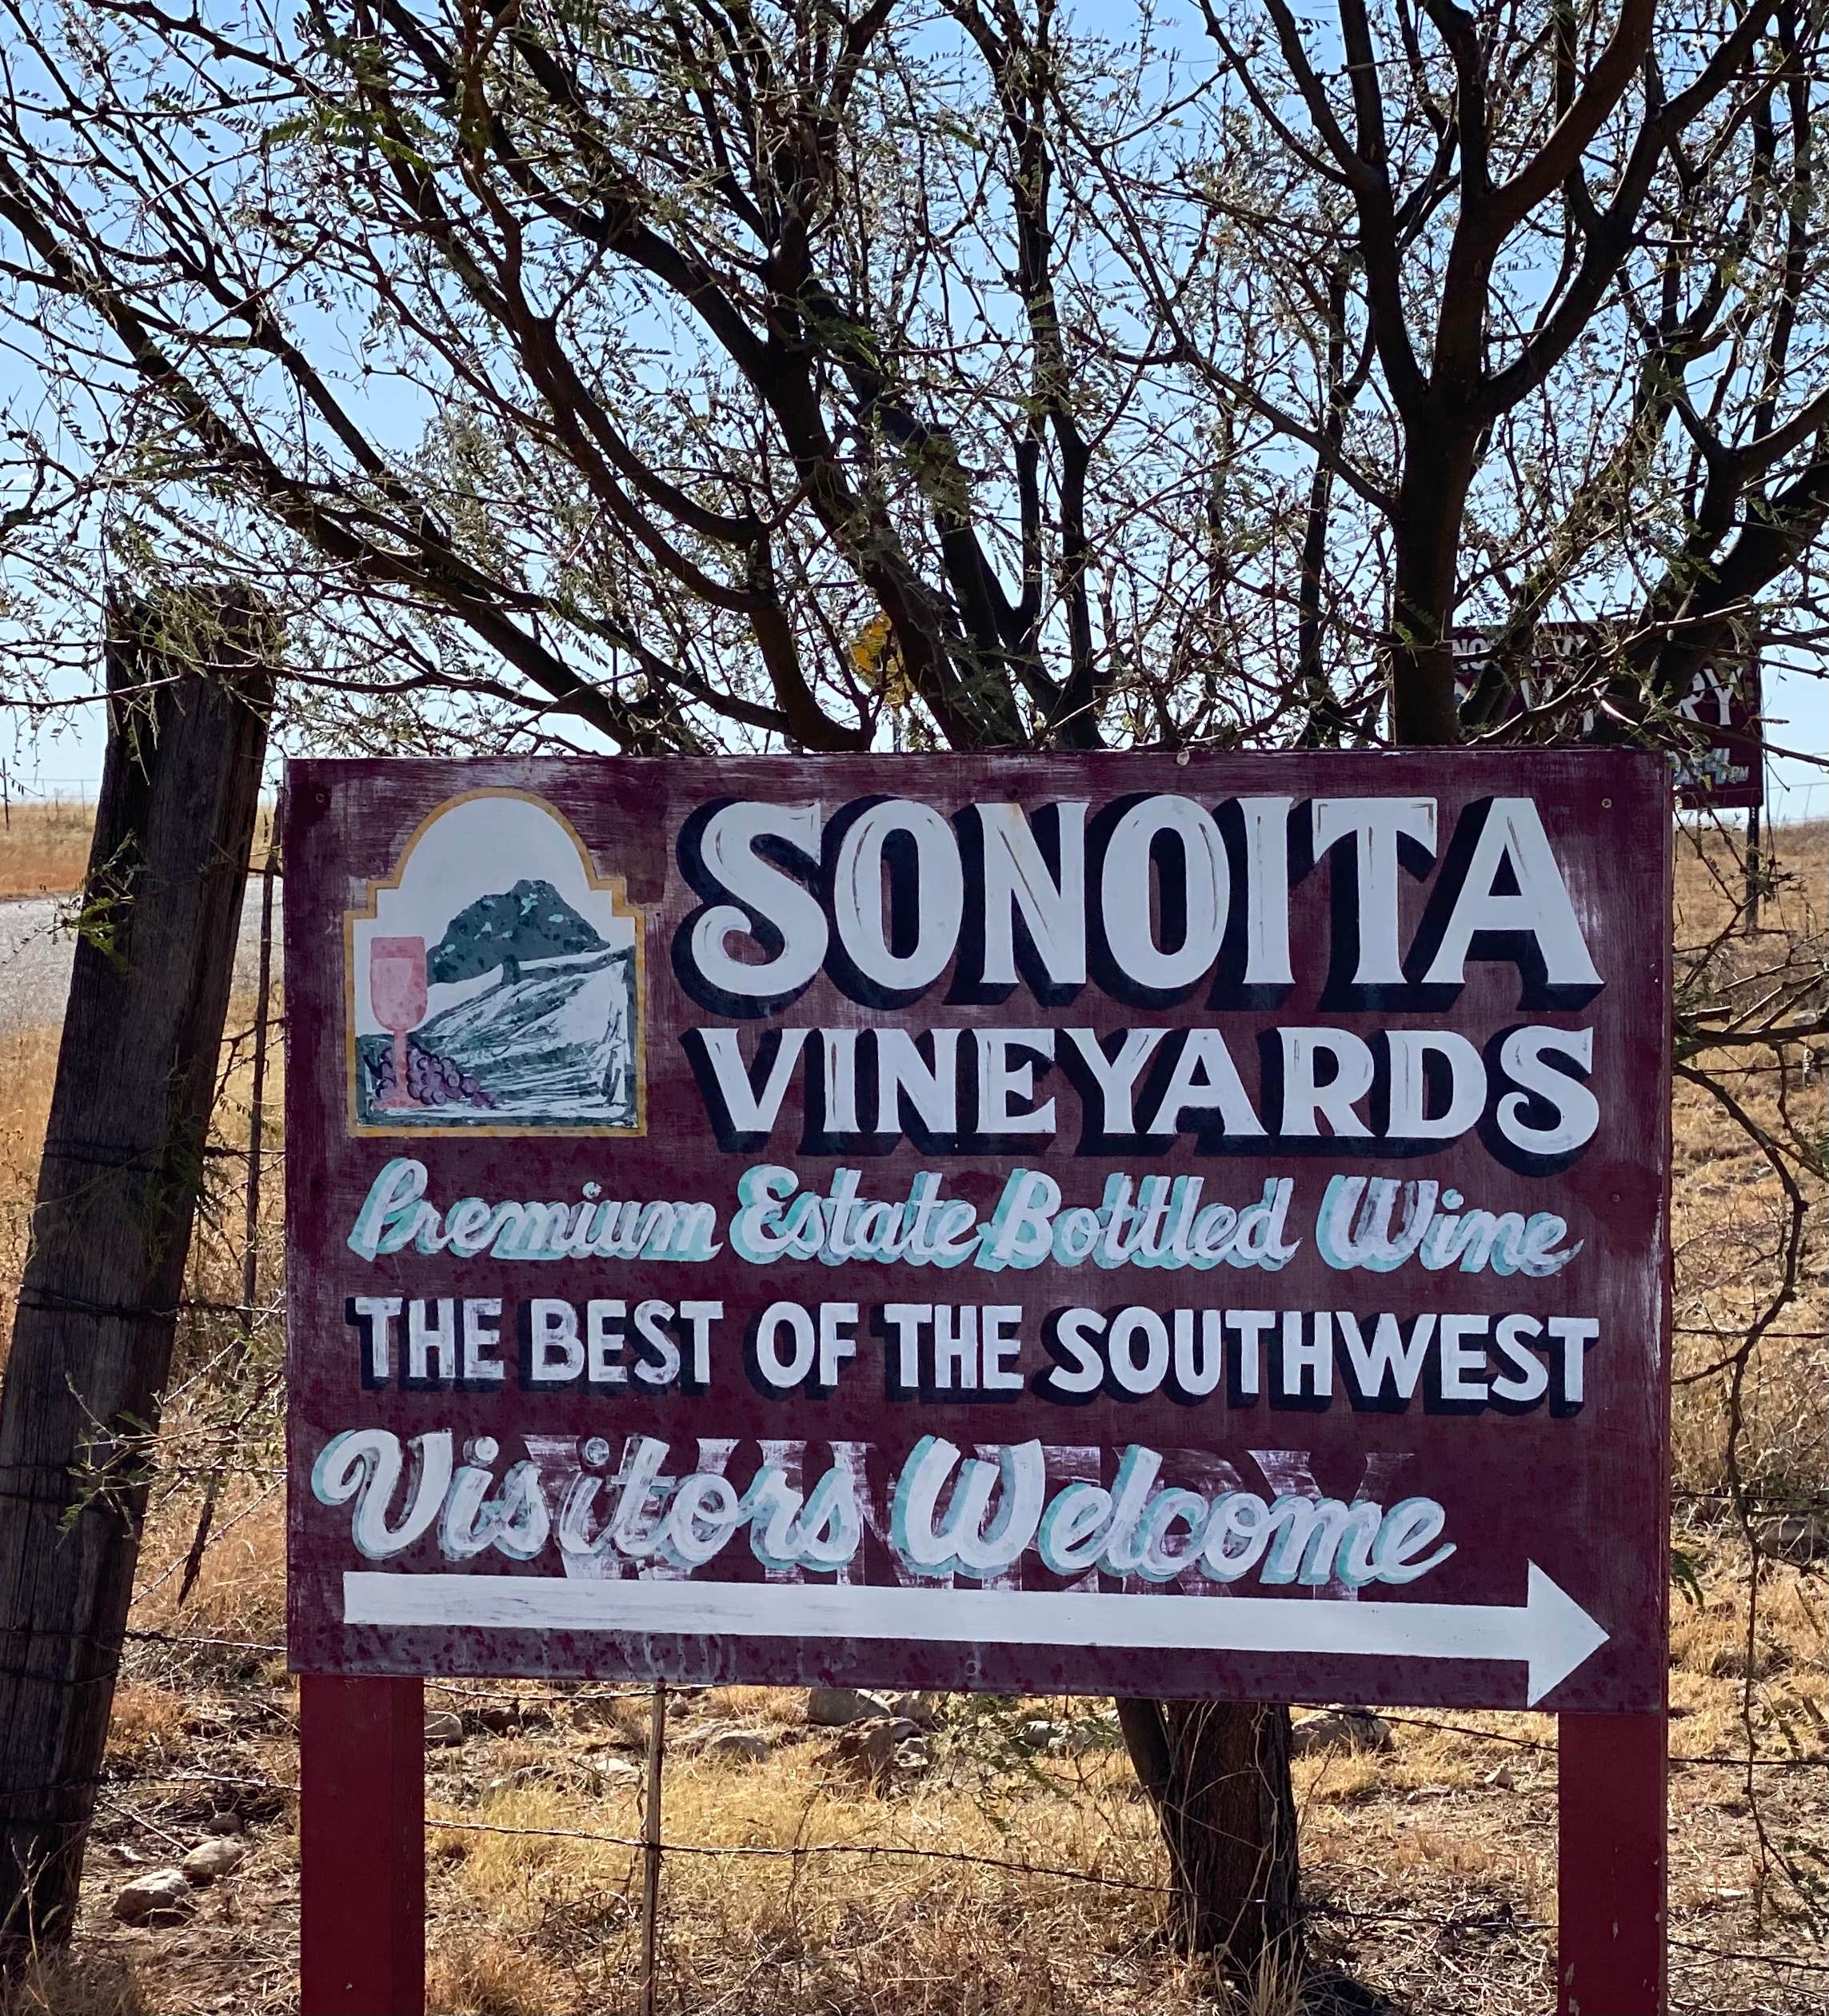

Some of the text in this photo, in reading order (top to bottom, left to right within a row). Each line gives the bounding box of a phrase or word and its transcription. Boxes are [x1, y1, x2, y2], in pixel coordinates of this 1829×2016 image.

[688, 793, 1606, 1000] SONOITA
[697, 1025, 1600, 1157] VINEYARDS
[347, 1158, 1585, 1278] Premium Estate Bottled Wine
[354, 1295, 1600, 1404] THE BEST OF THE SOUTHWEST
[311, 1428, 864, 1571] Visitors
[888, 1435, 1457, 1587] Welcome
